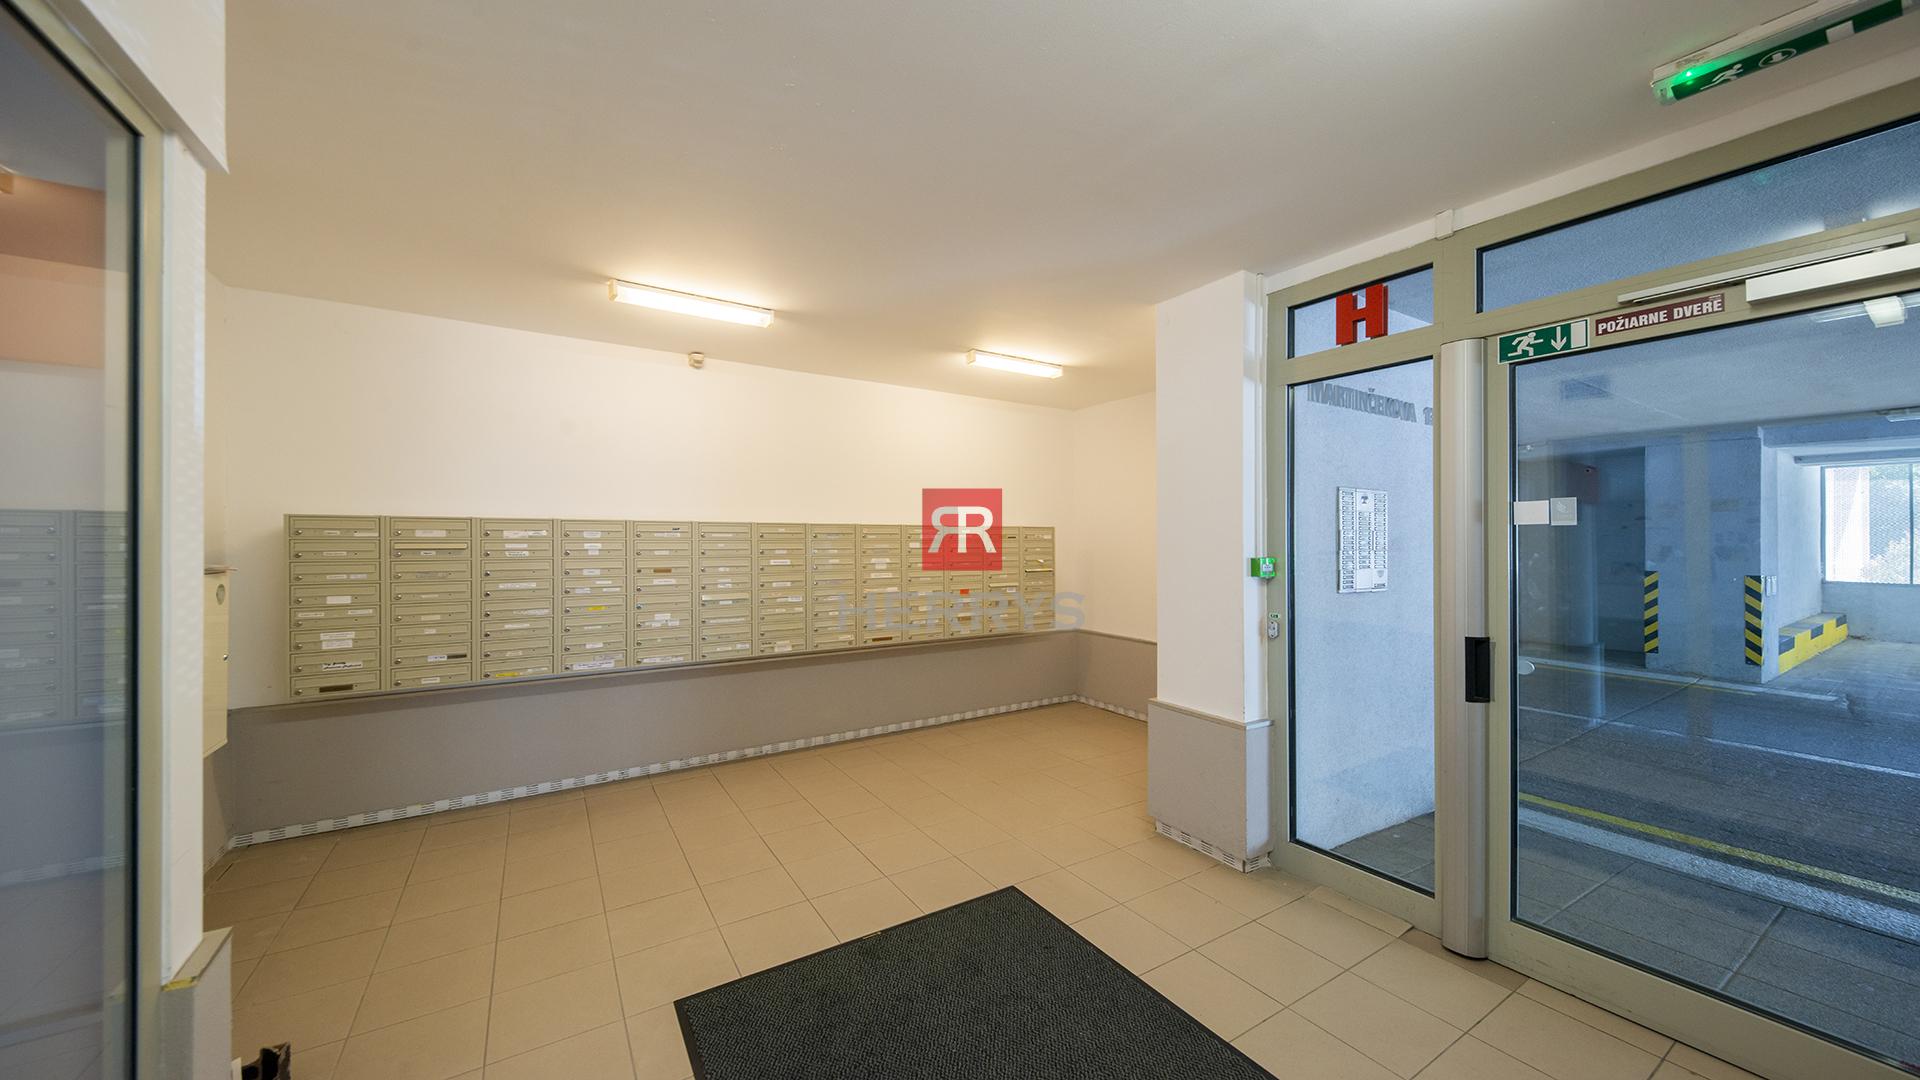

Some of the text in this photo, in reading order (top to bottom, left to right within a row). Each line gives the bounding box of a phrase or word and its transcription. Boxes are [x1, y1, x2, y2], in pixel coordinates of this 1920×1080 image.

[1336, 284, 1388, 346] H
[1598, 299, 1723, 335] POŽIARNE DVERE
[1307, 382, 1417, 423] MARTINČEKOVA
